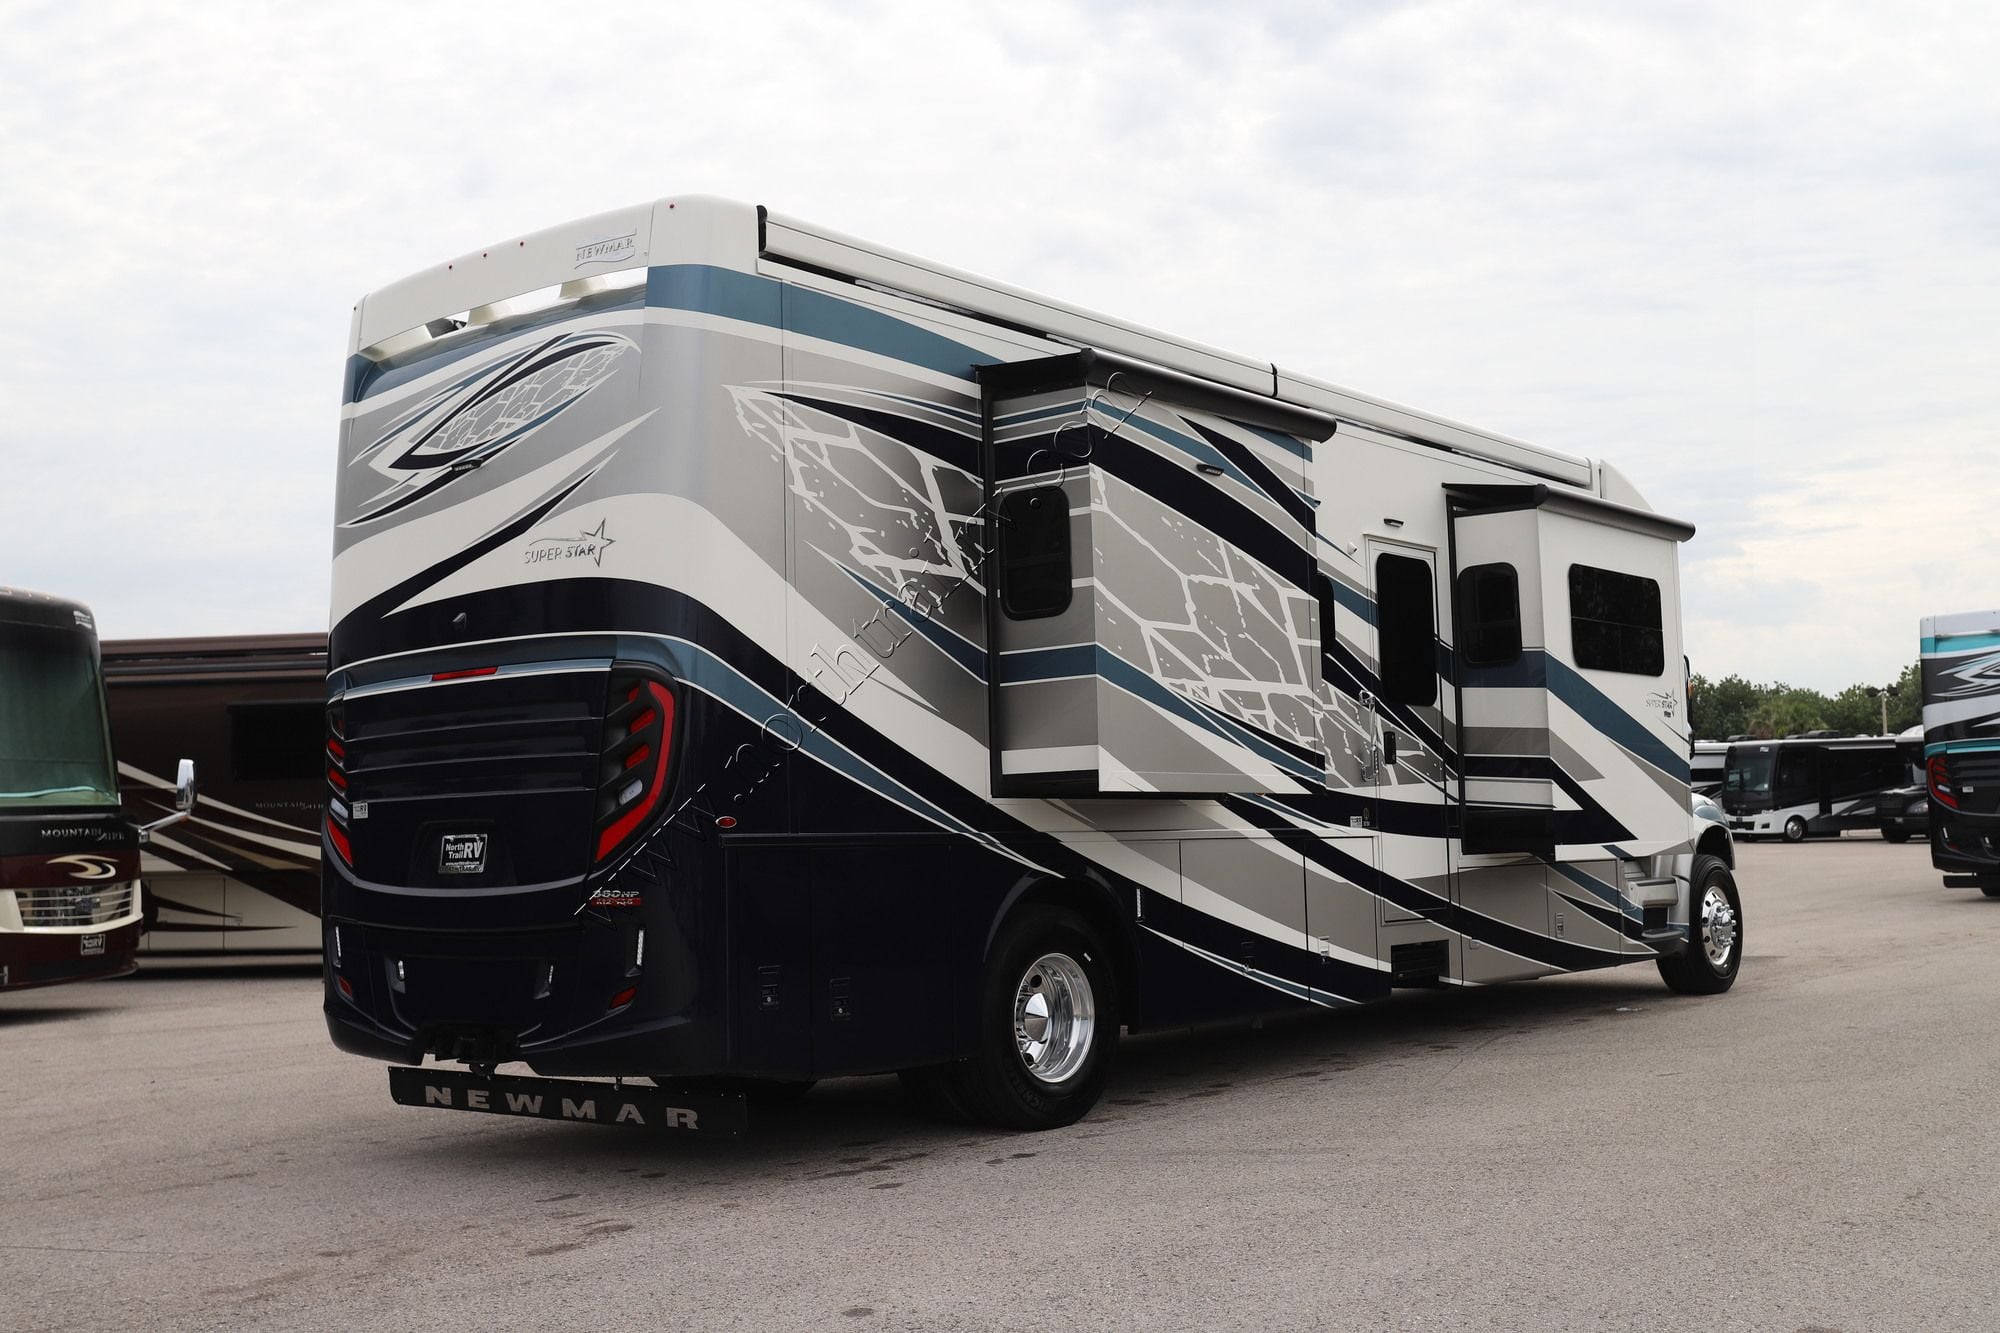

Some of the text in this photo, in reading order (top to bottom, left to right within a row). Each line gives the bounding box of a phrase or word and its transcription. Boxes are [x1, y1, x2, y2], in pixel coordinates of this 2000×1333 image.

[576, 238, 635, 261] NEWMAR
[525, 543, 596, 564] SUPER STAR
[41, 828, 102, 838] MOUNTAIN
[446, 842, 464, 850] North
[463, 841, 483, 858] RV
[425, 1085, 700, 1131] NEWMAR
